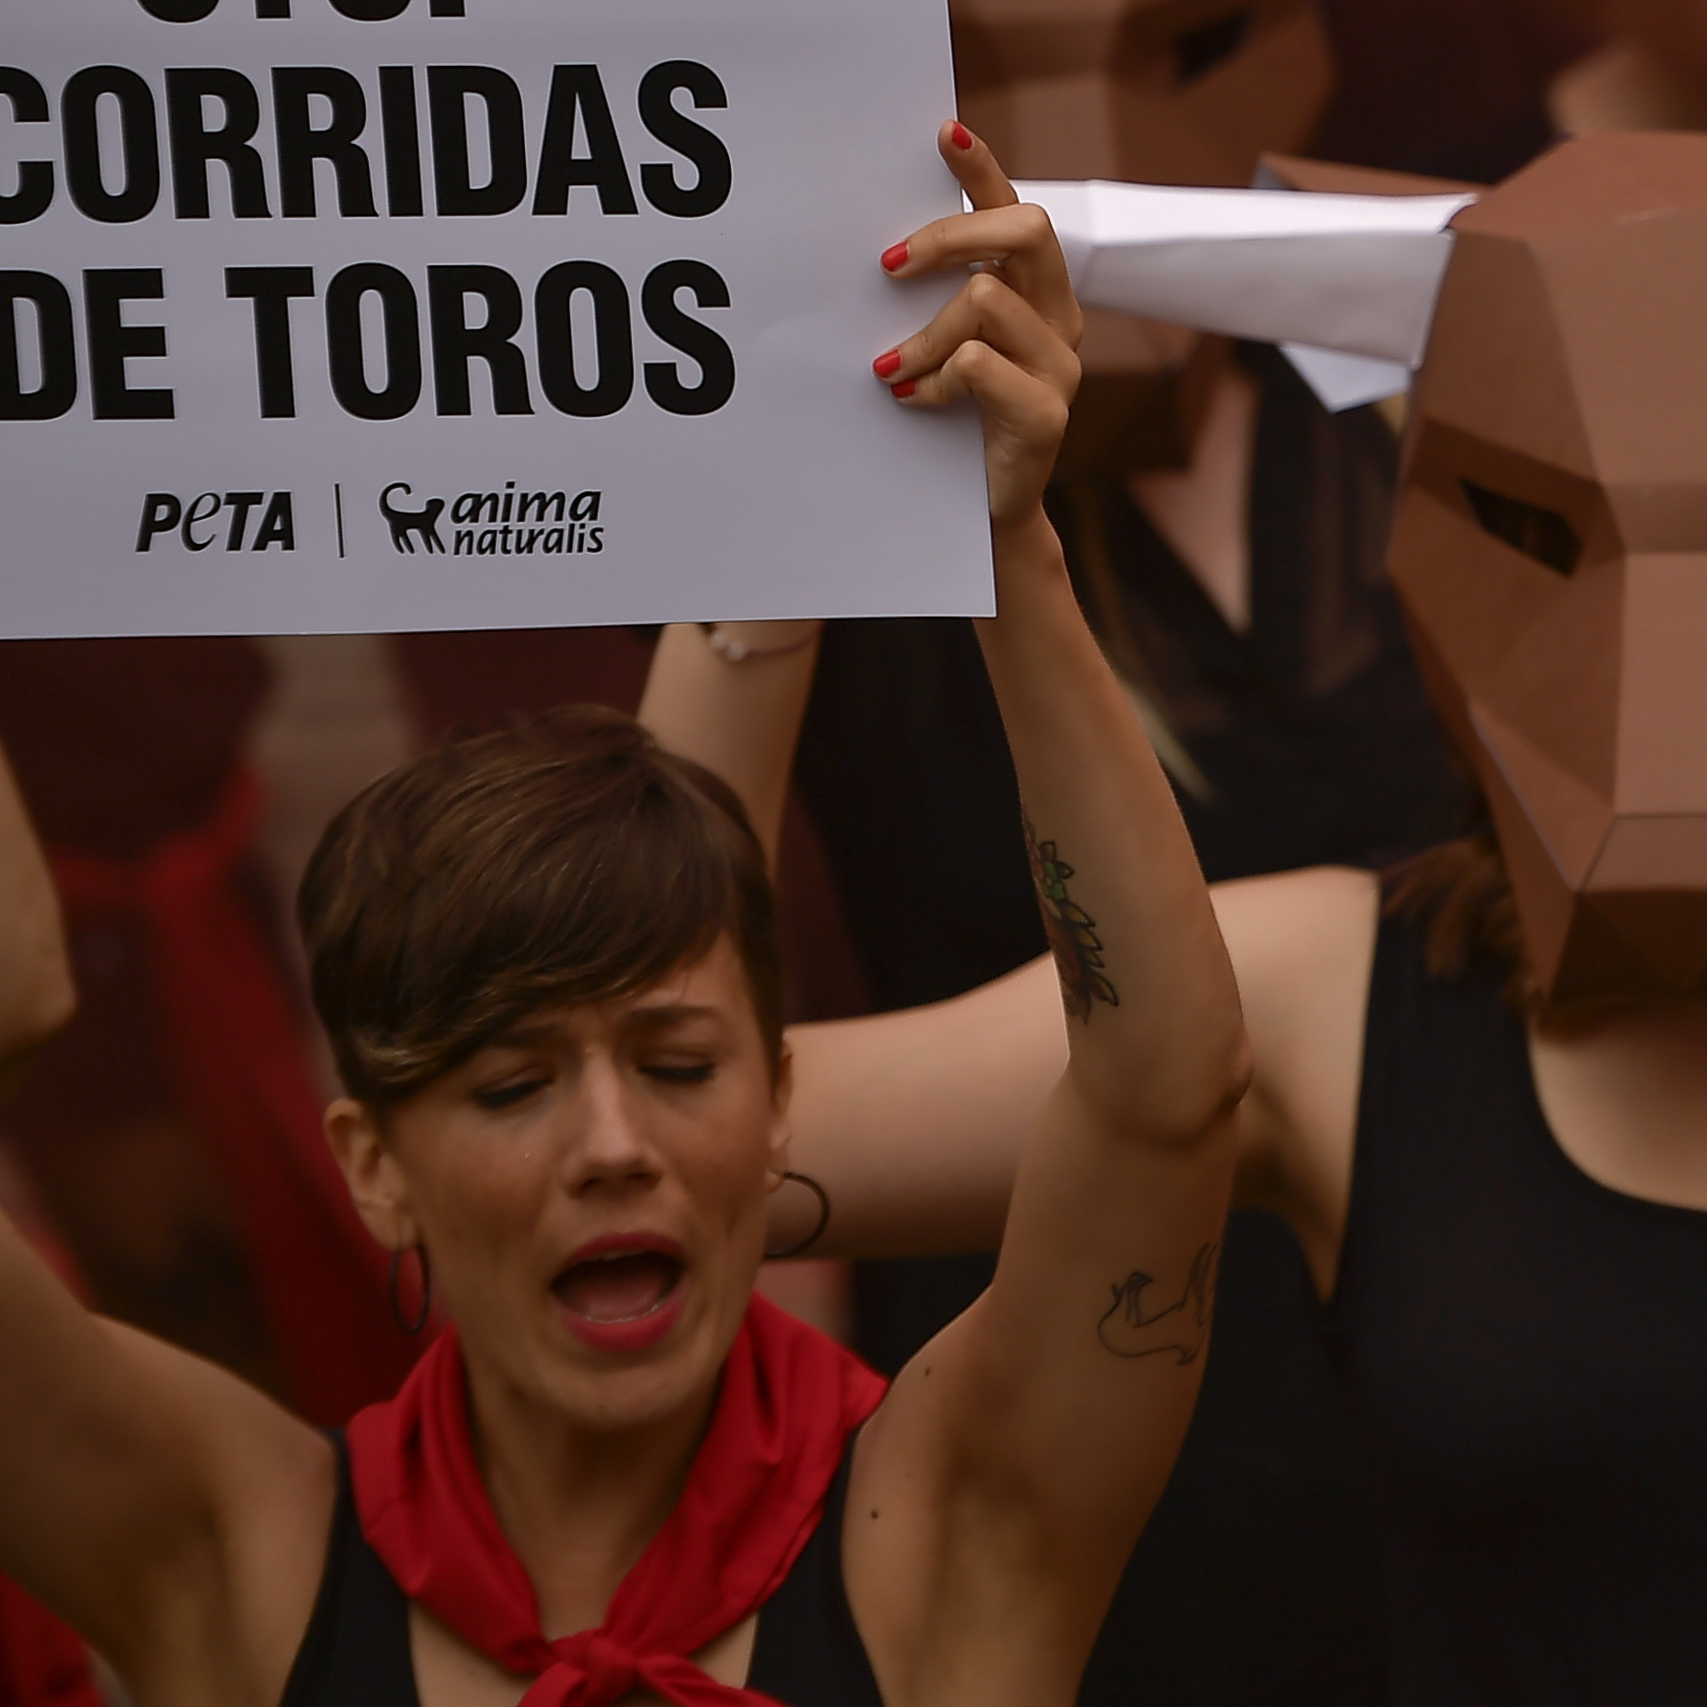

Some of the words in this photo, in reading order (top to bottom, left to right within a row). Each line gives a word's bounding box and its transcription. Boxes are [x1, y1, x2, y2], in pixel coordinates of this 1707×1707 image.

[0, 268, 175, 421] DE
[225, 260, 735, 420] TOROS
[451, 482, 601, 523] anima
[454, 523, 603, 555] naturalis
